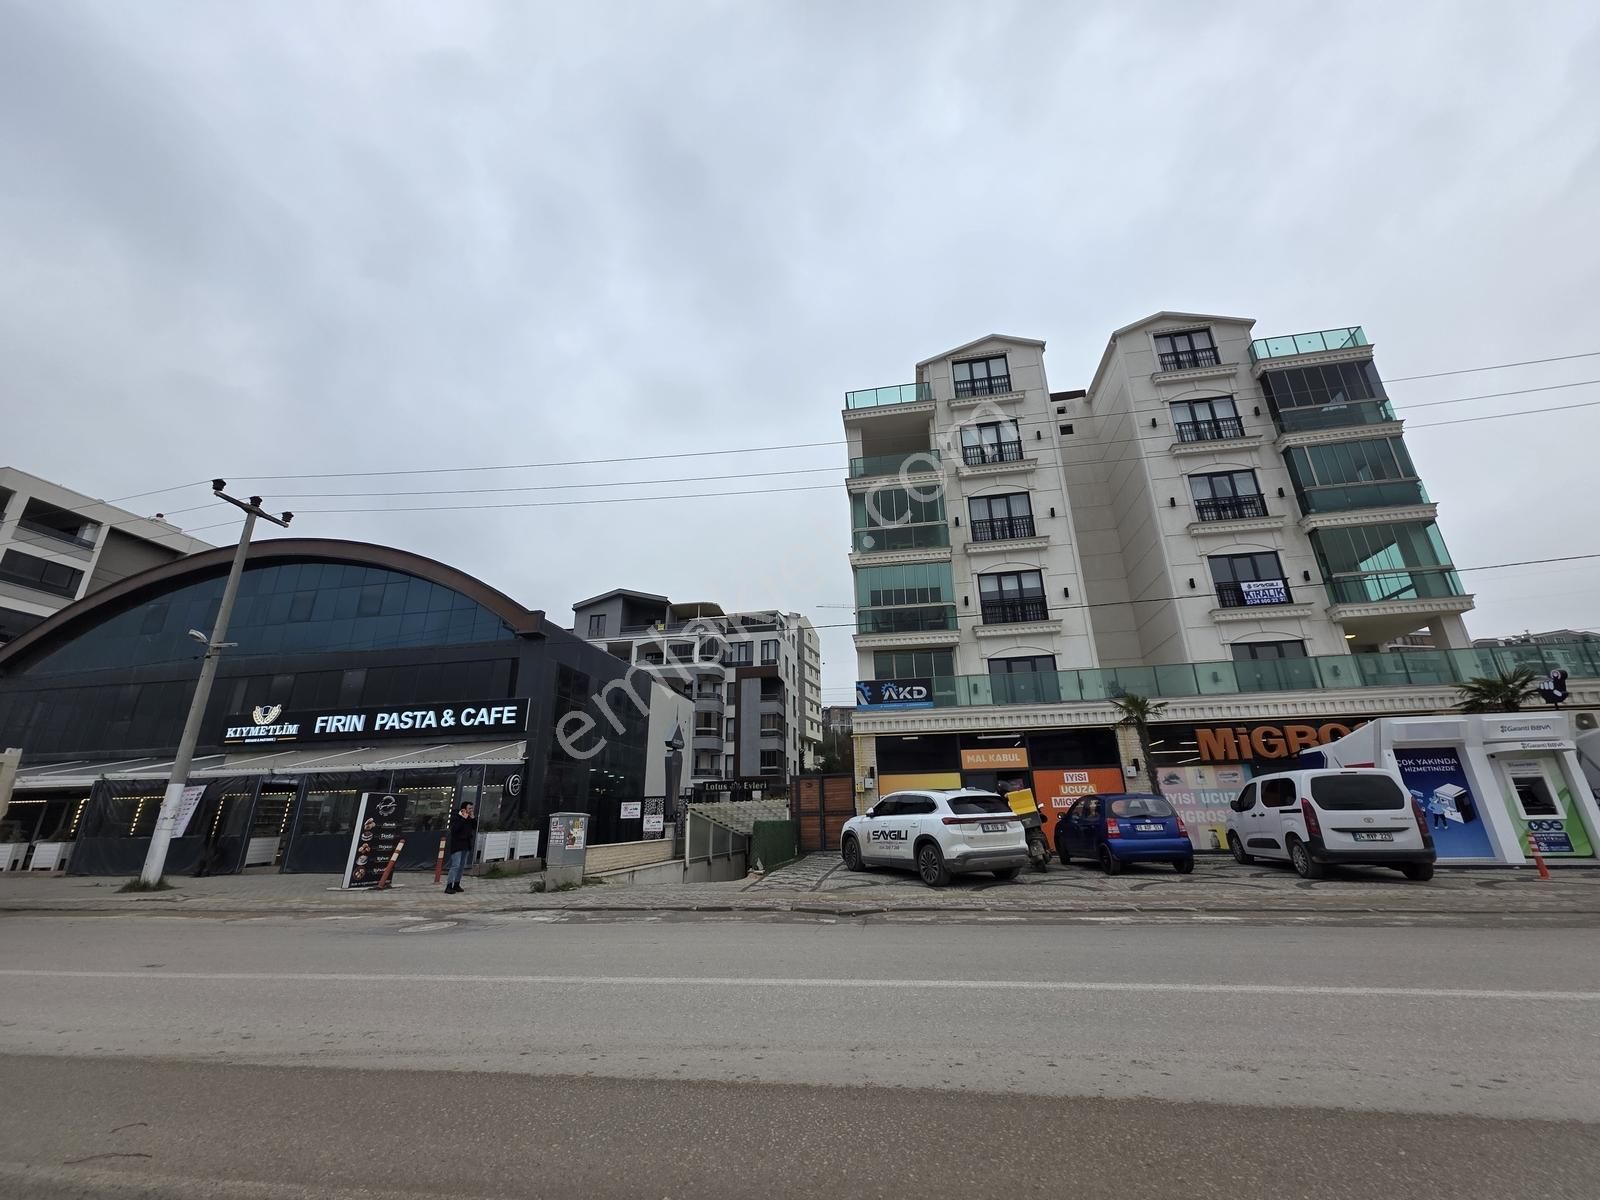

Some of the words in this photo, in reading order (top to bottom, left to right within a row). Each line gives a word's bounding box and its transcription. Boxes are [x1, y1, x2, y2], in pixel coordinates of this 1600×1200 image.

[883, 686, 927, 700] AKD
[314, 714, 366, 734] FIRIN
[374, 710, 438, 731] PASTA
[440, 709, 456, 727] &
[460, 706, 518, 726] CAFE
[1195, 722, 1372, 763] MiGRO
[989, 753, 1021, 763] KABUL
[1416, 757, 1457, 765] YAKINDA
[1060, 785, 1097, 794] UCUZA
